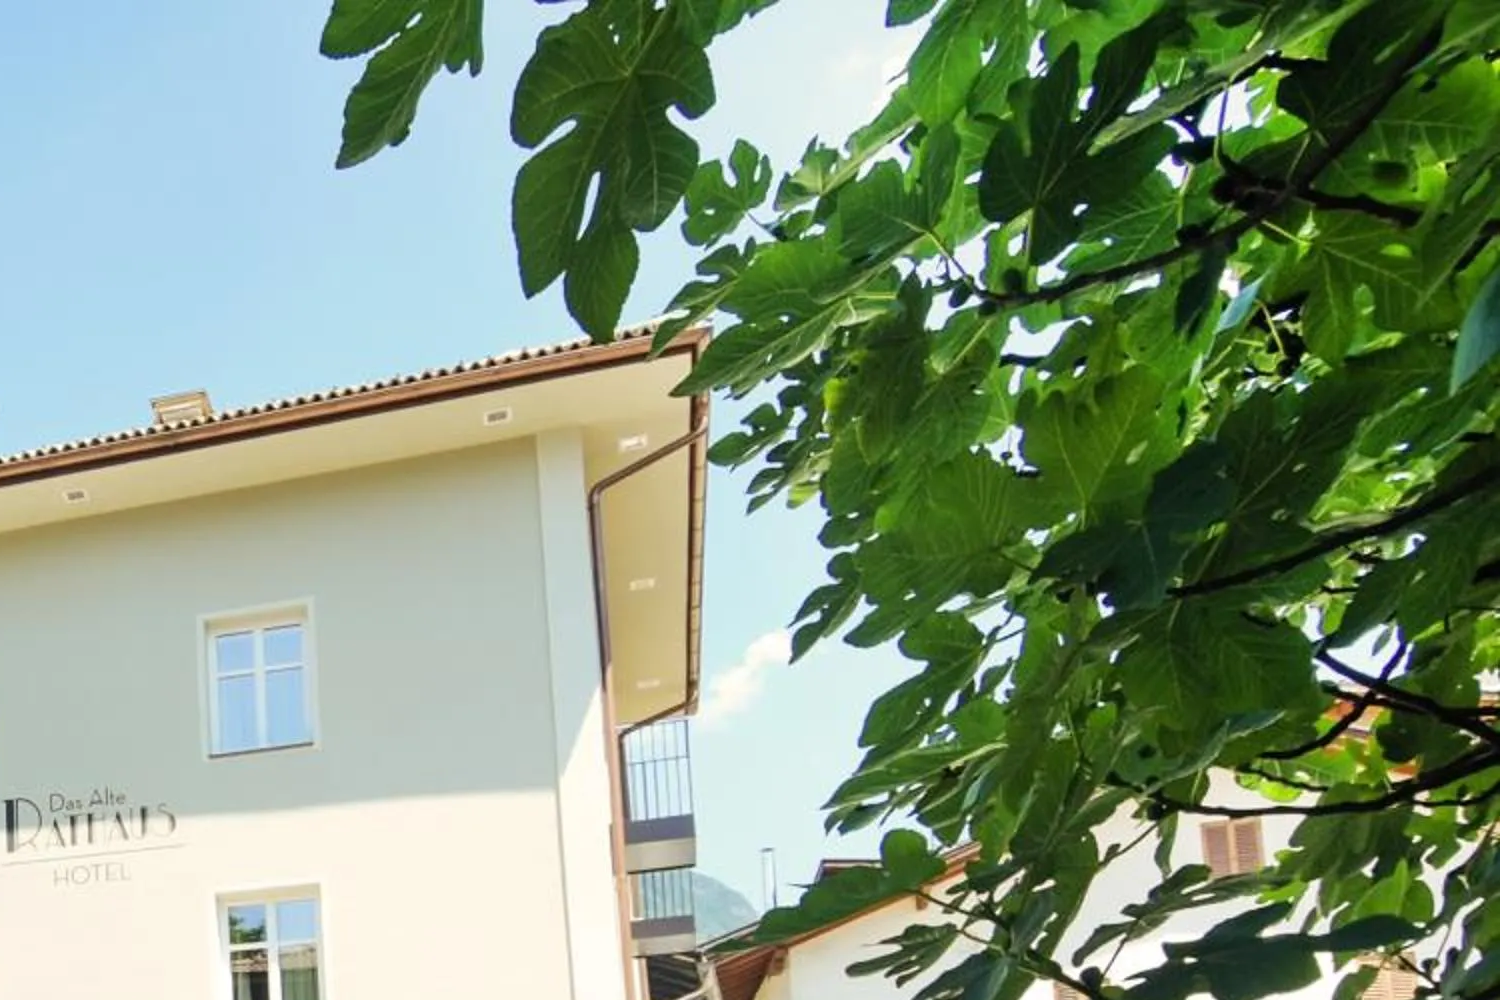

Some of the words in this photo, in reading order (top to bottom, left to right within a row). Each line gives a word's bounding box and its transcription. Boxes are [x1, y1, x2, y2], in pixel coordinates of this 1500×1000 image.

[49, 793, 83, 812] Das
[89, 786, 126, 806] Alte
[53, 862, 131, 886] HOTEL
